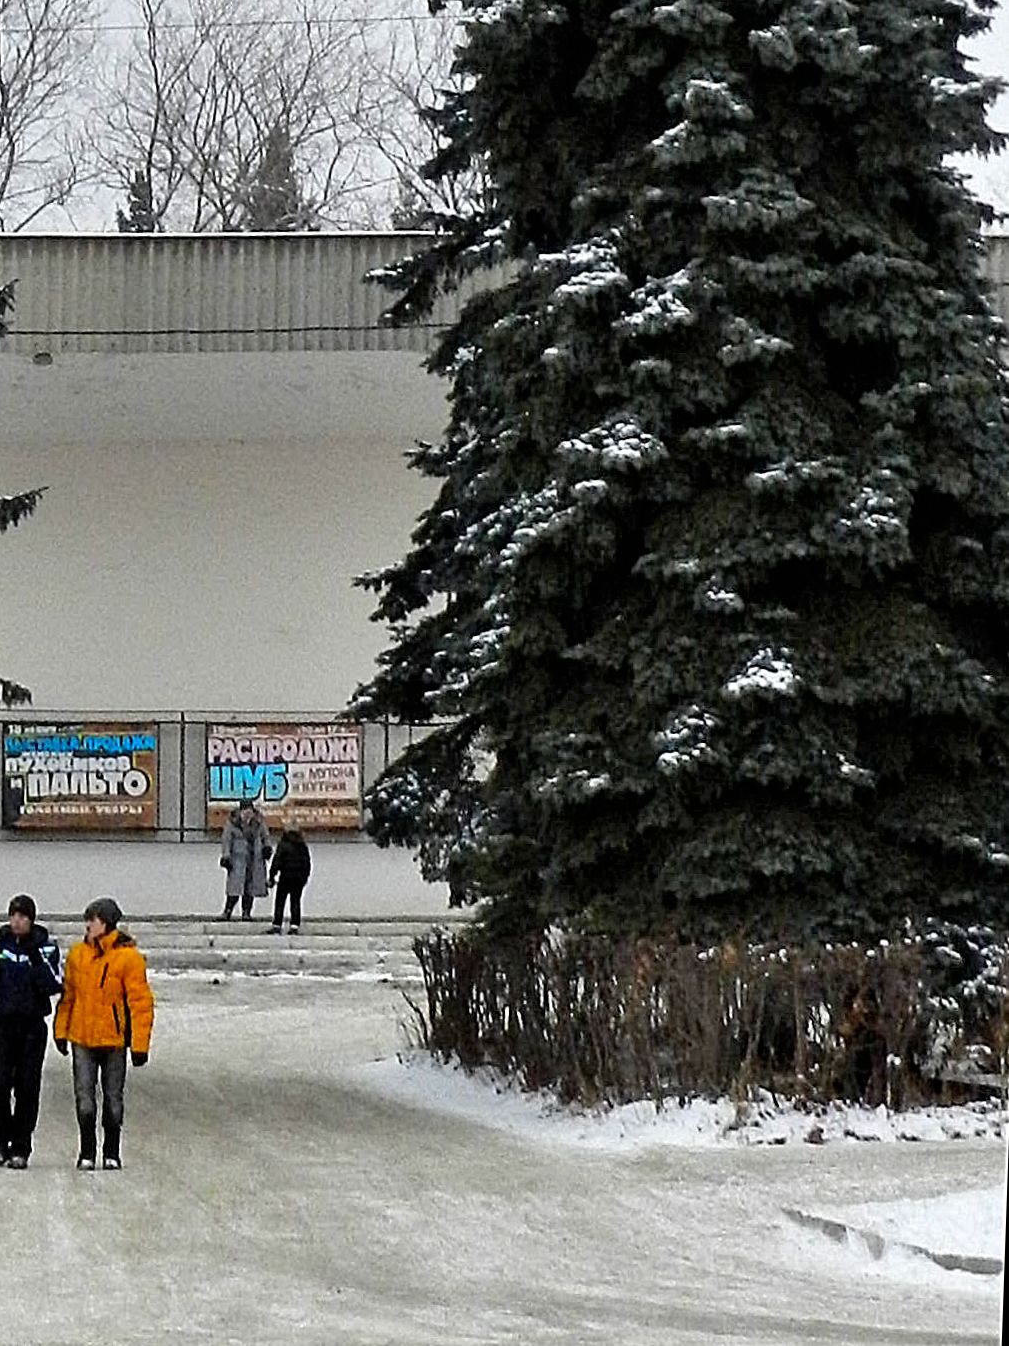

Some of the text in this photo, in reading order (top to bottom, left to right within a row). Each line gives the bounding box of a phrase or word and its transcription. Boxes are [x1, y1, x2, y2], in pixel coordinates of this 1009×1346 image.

[5, 755, 131, 772] ПУХОВИКОВ
[207, 737, 359, 763] РАСПРОДАЖА
[27, 769, 148, 797] ПАЛЬТО
[209, 763, 288, 801] ШУБ
